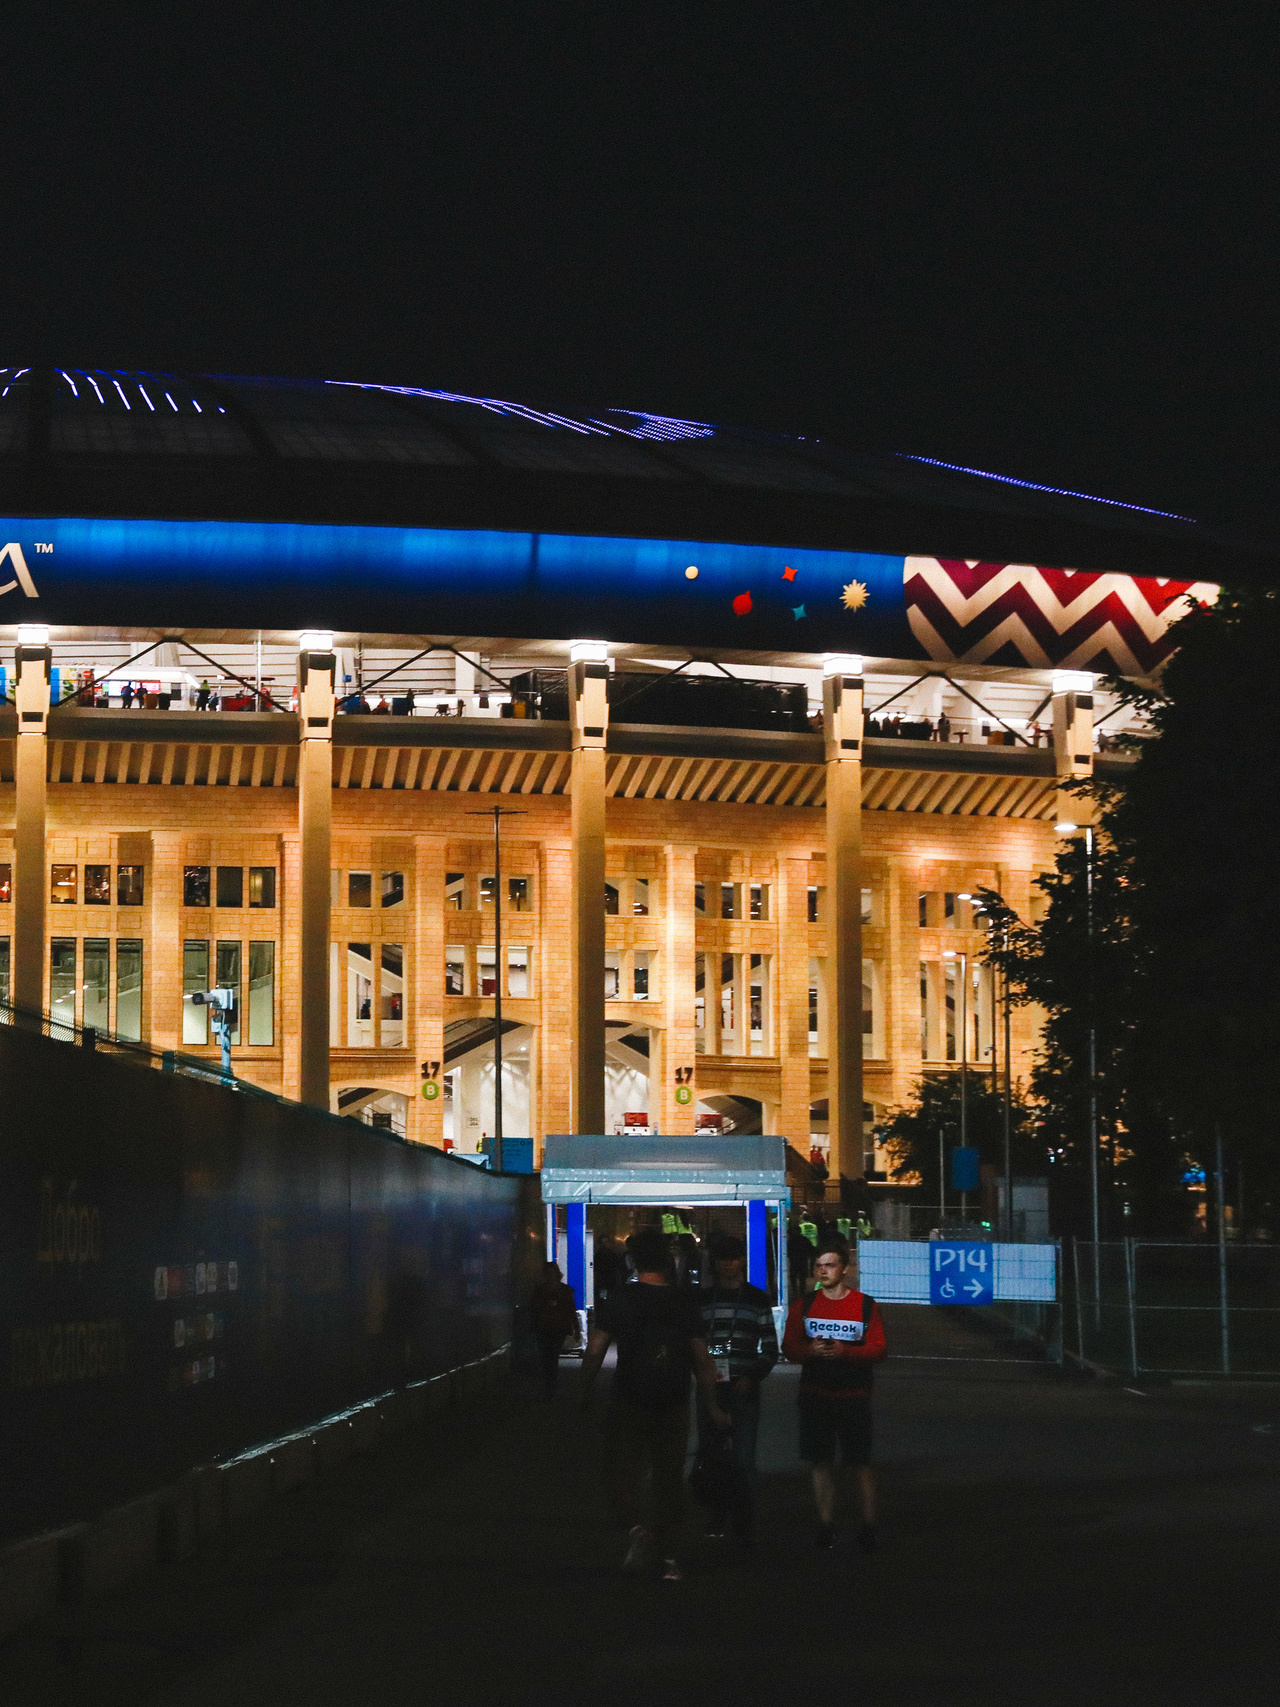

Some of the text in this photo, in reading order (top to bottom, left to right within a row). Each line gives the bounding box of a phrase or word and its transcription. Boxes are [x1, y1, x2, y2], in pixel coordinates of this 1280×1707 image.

[421, 1061, 441, 1080] 17
[675, 1066, 694, 1085] 17
[935, 1248, 988, 1273] P14
[809, 1320, 857, 1333] Reebok
